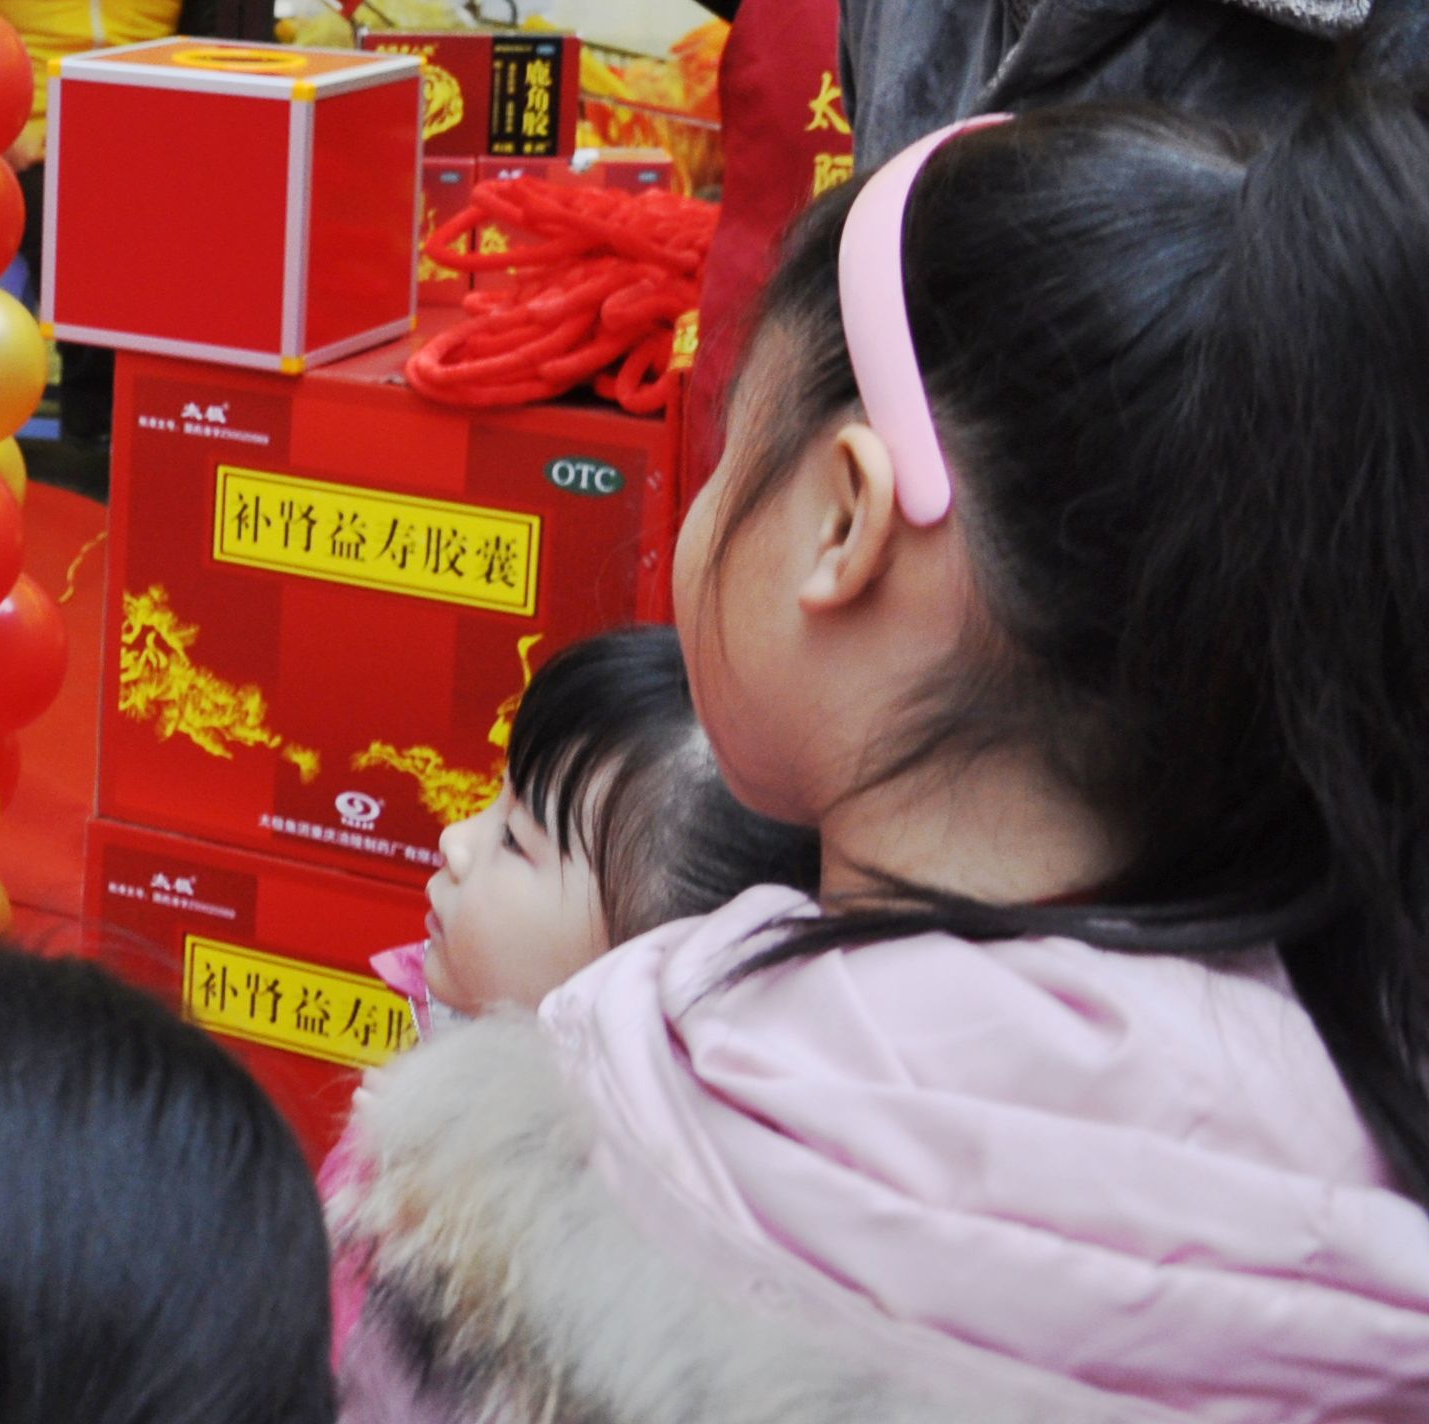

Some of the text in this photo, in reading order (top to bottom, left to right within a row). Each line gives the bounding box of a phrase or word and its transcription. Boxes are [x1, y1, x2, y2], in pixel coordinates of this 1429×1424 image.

[551, 459, 617, 495] OTC
[229, 490, 520, 591] 补肾益寿胶囊
